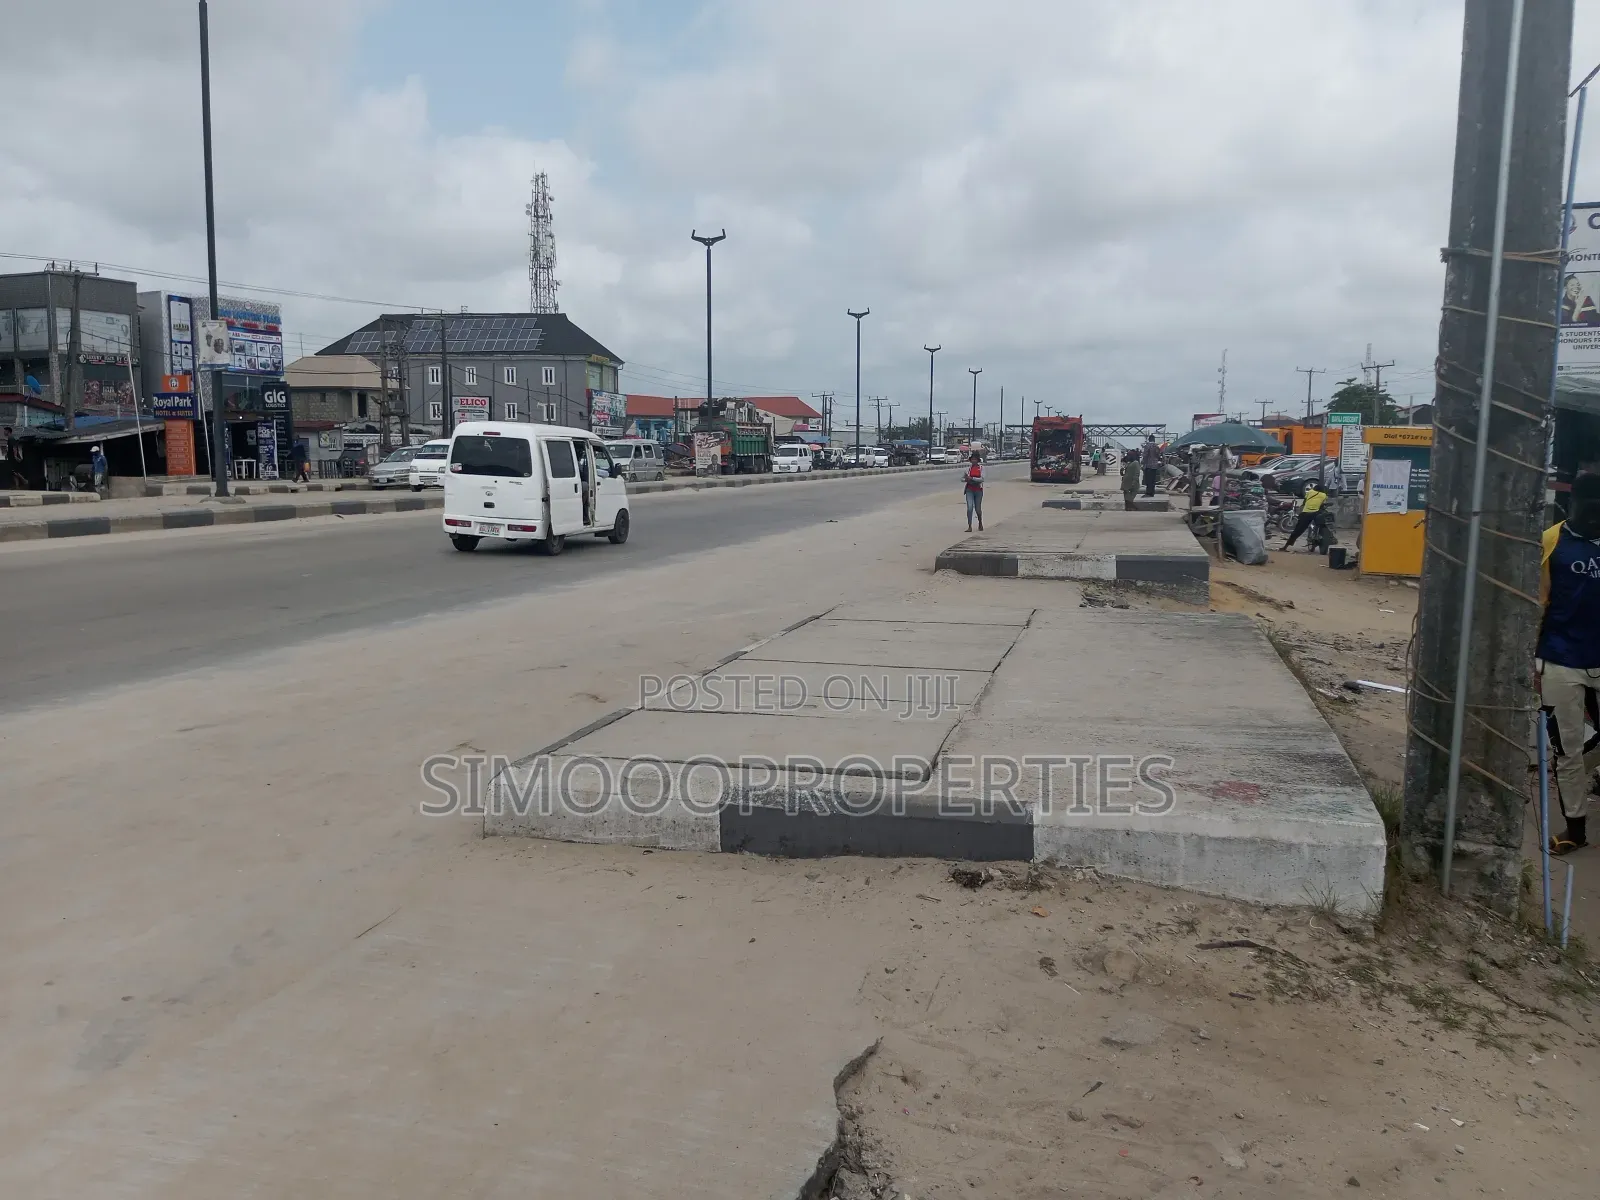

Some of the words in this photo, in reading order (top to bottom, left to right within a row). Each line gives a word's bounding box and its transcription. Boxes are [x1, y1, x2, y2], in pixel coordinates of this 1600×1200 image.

[153, 396, 174, 409] Royal
[174, 396, 192, 407] Park
[264, 389, 287, 404] GIG
[459, 398, 487, 406] ELICO
